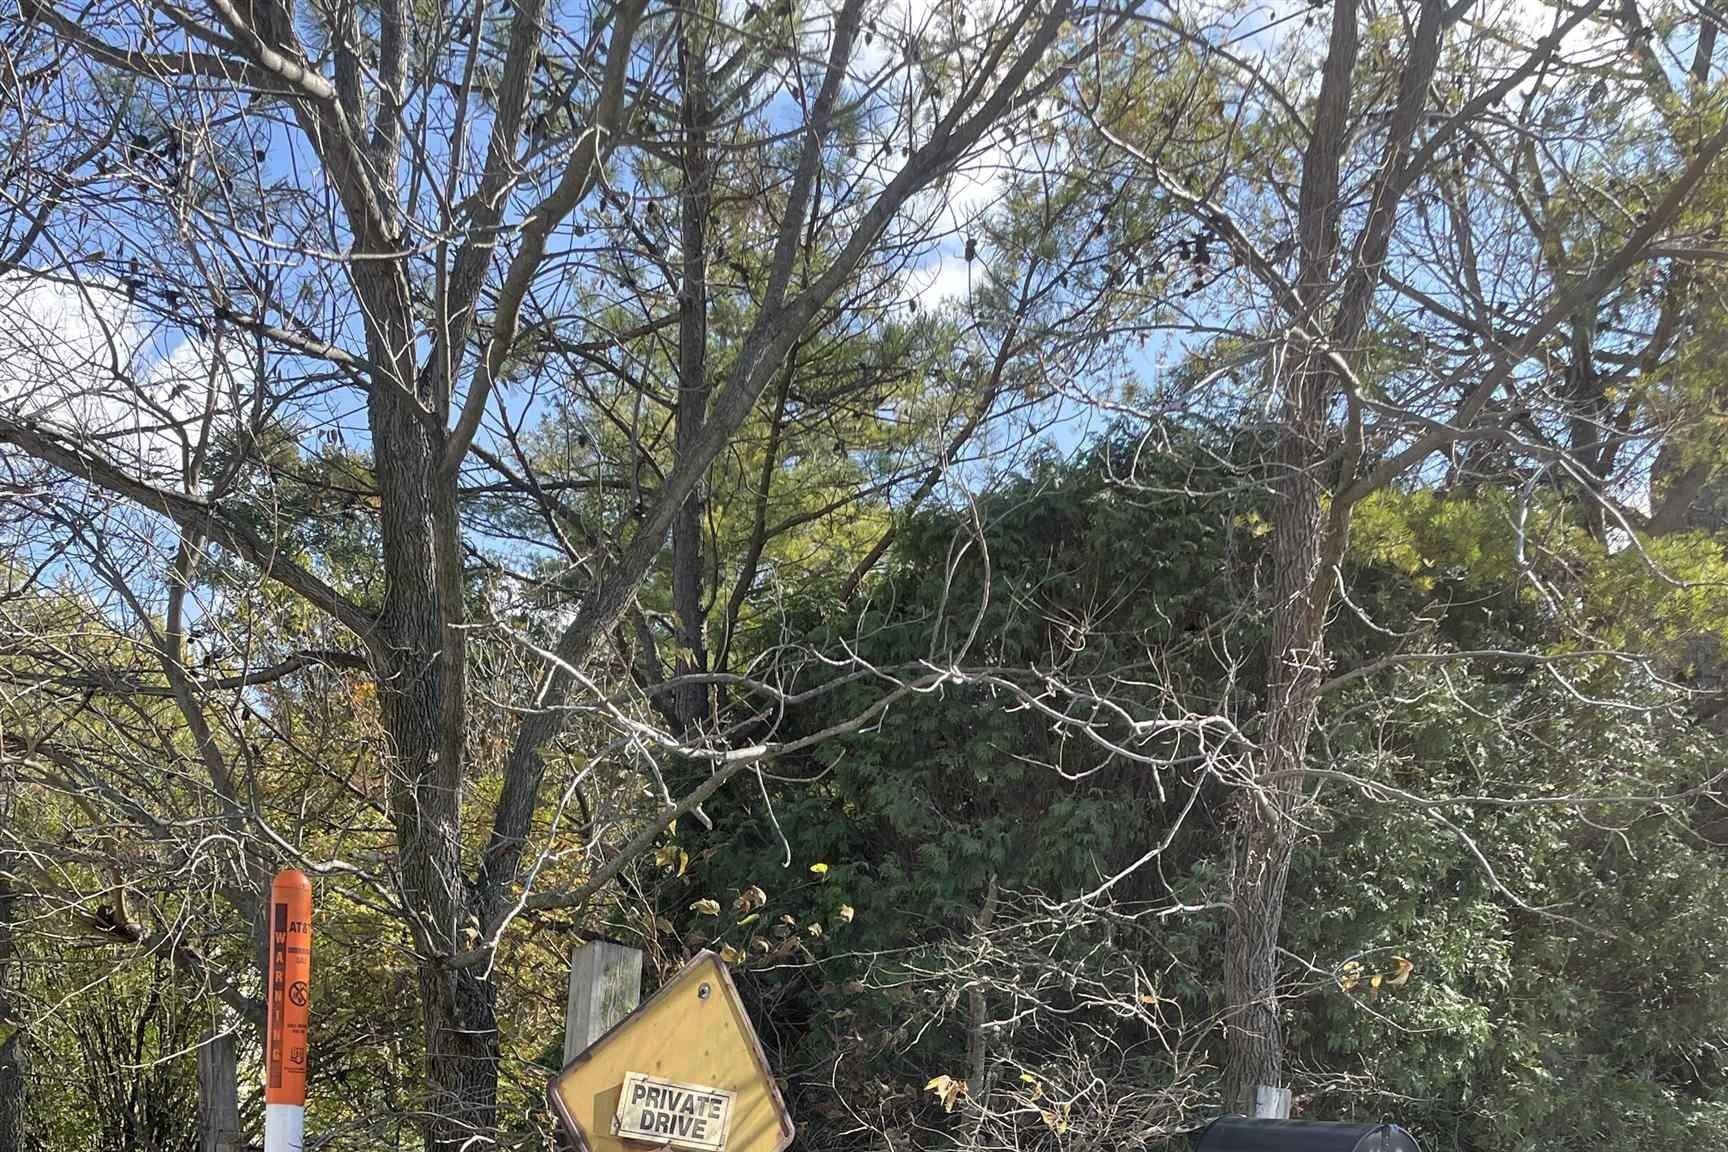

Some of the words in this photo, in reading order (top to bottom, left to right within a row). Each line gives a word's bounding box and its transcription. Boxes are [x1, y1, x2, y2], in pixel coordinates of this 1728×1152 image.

[272, 931, 286, 1062] WARNING
[631, 1084, 722, 1119] PRIVATE
[640, 1109, 707, 1139] DRIVE
